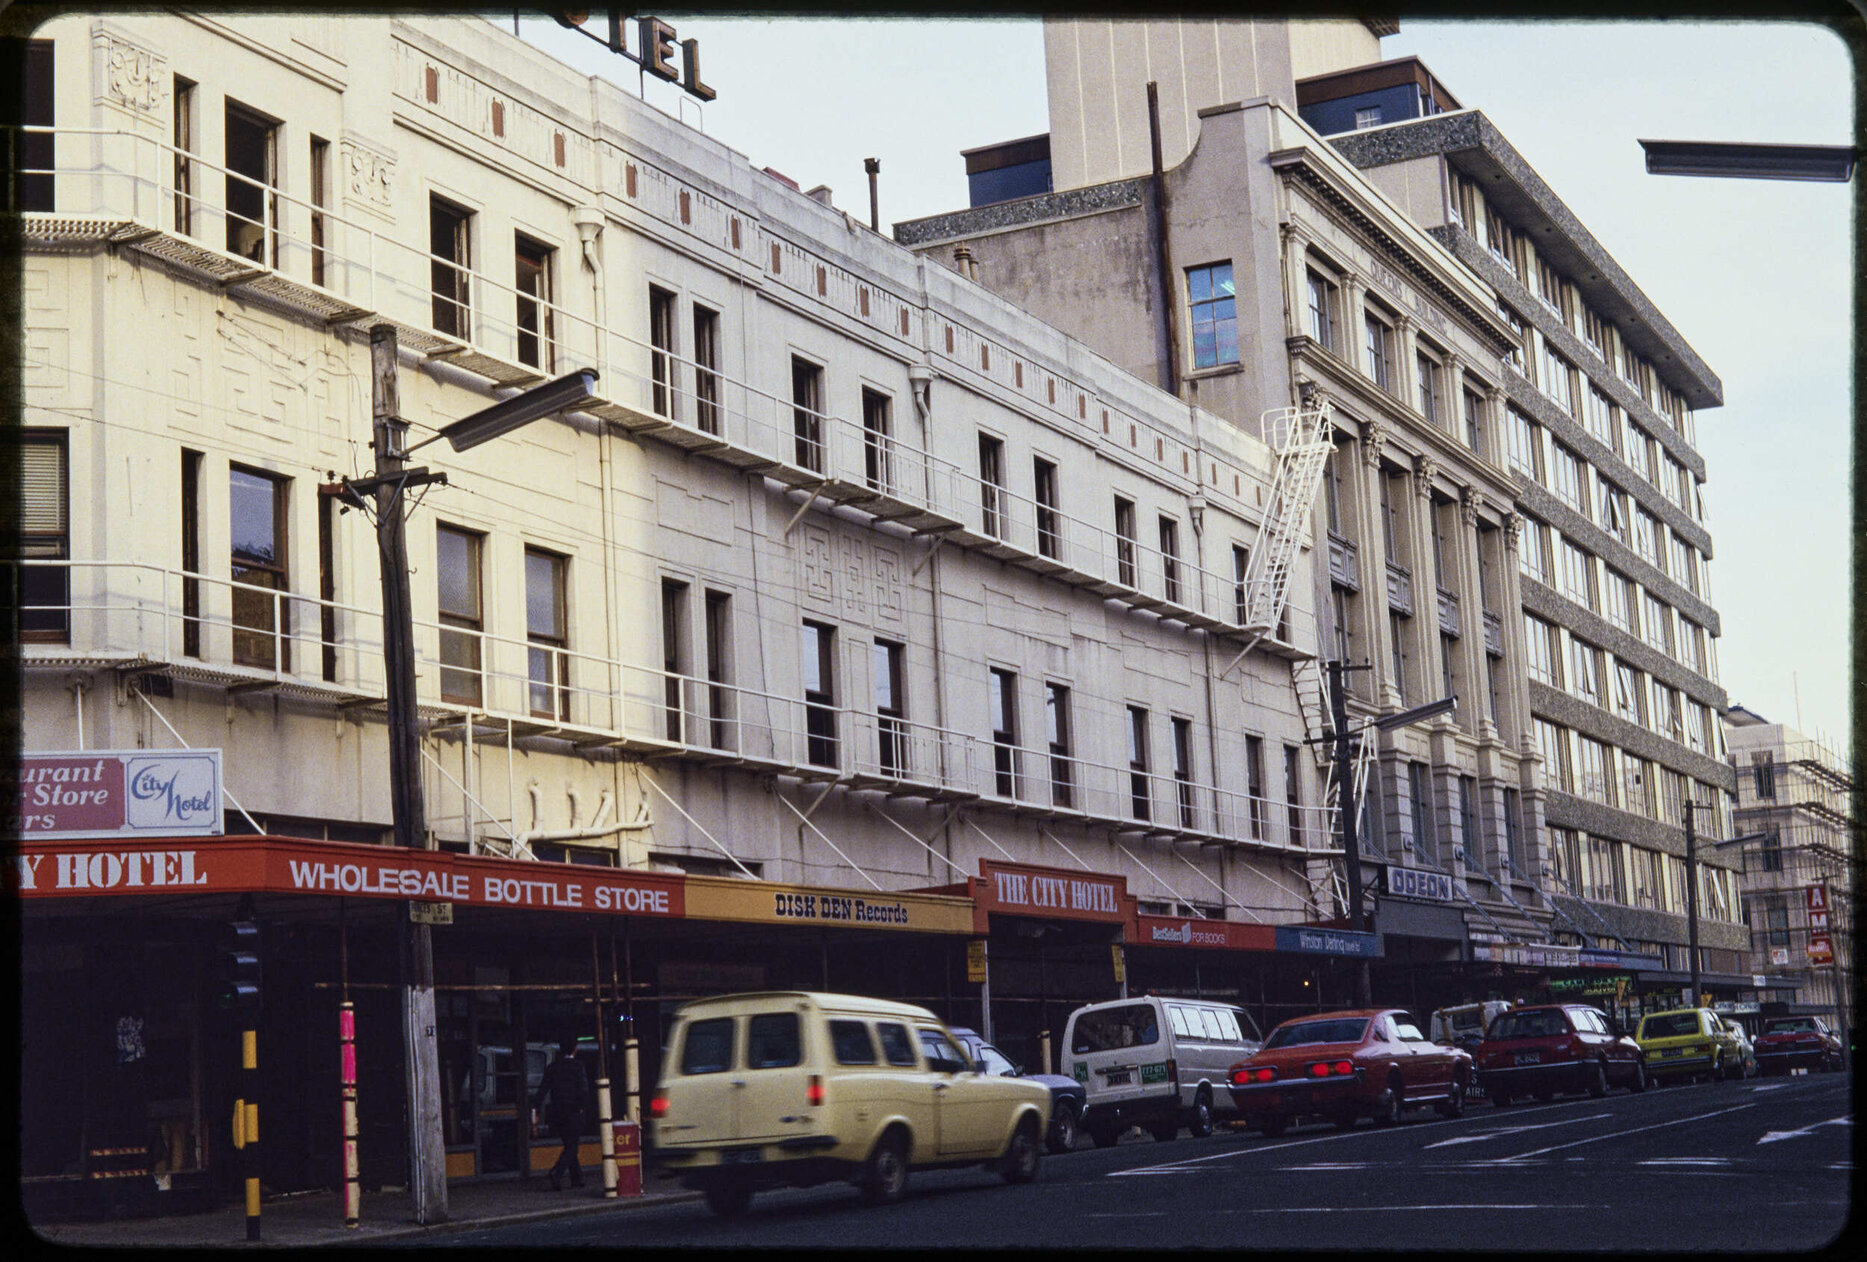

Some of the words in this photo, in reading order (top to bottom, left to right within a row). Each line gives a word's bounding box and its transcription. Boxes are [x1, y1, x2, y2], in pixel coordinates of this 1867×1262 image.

[549, 9, 716, 102] TEL
[33, 784, 109, 807] Store
[131, 764, 170, 801] City
[56, 850, 208, 889] HOTEL
[289, 859, 470, 900] WHOLESALE
[484, 876, 583, 908] BOTTLE
[595, 886, 669, 913] STORE
[1393, 869, 1449, 899] ODEON
[775, 893, 817, 919] DISK
[820, 896, 852, 921] DEN
[855, 899, 909, 925] Records
[995, 872, 1029, 906] THE
[1032, 875, 1068, 909] CITY
[1072, 880, 1118, 914] HOTEL
[1205, 933, 1226, 945] BOOKS
